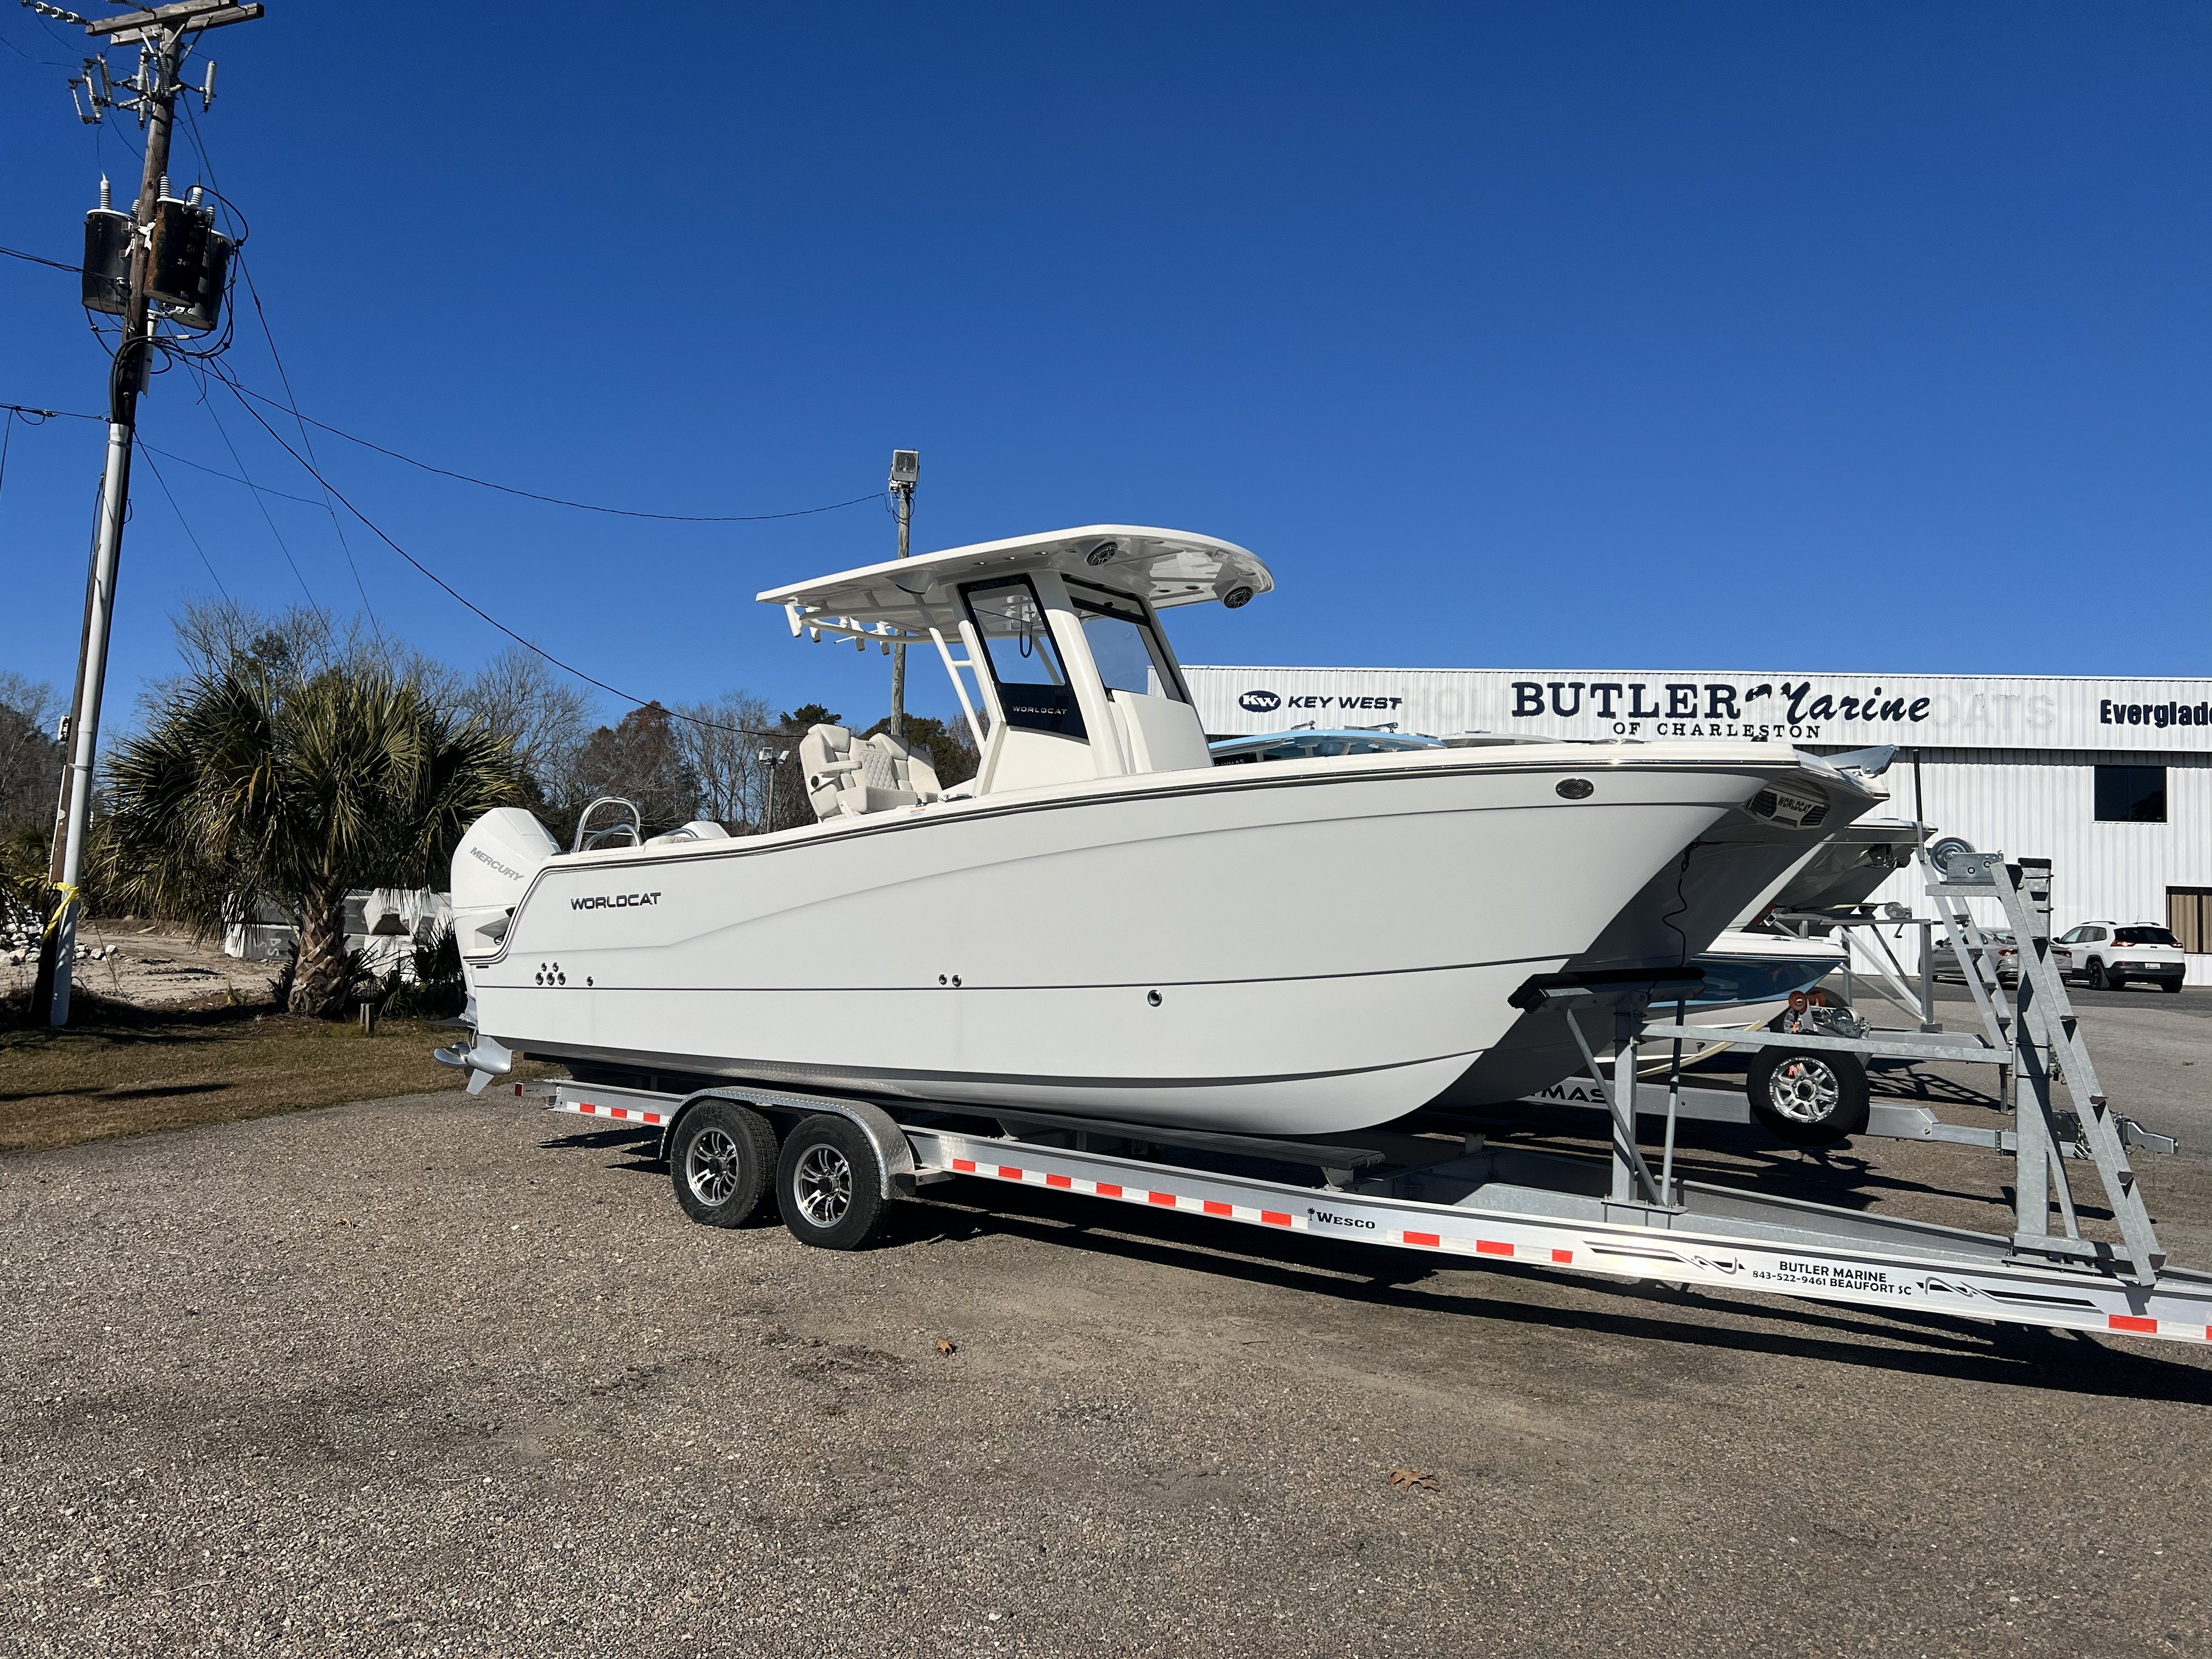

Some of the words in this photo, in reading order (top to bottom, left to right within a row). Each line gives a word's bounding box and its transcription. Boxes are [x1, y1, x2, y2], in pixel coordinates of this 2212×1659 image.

[1242, 693, 1279, 708] KW
[1288, 696, 1334, 708] KEY
[1339, 697, 1402, 710] WEST
[1511, 681, 1741, 719] BUTLER
[1745, 681, 1930, 725] Marine
[1013, 706, 1068, 715] WORLDCAT
[2100, 699, 2212, 728] Everglad
[1613, 722, 1641, 736] OF
[1657, 723, 1820, 738] CHARLESTON
[1778, 795, 1812, 813] WORLDCAT
[470, 847, 525, 882] MERCURY
[570, 892, 662, 910] WORLDCAT
[1779, 1261, 1829, 1277] BUTLER
[1833, 1266, 1887, 1283] MARINE
[1752, 1270, 1827, 1286] 843-522-9461
[1830, 1278, 1894, 1294] BEAUFORT
[1898, 1285, 1912, 1295] SC
